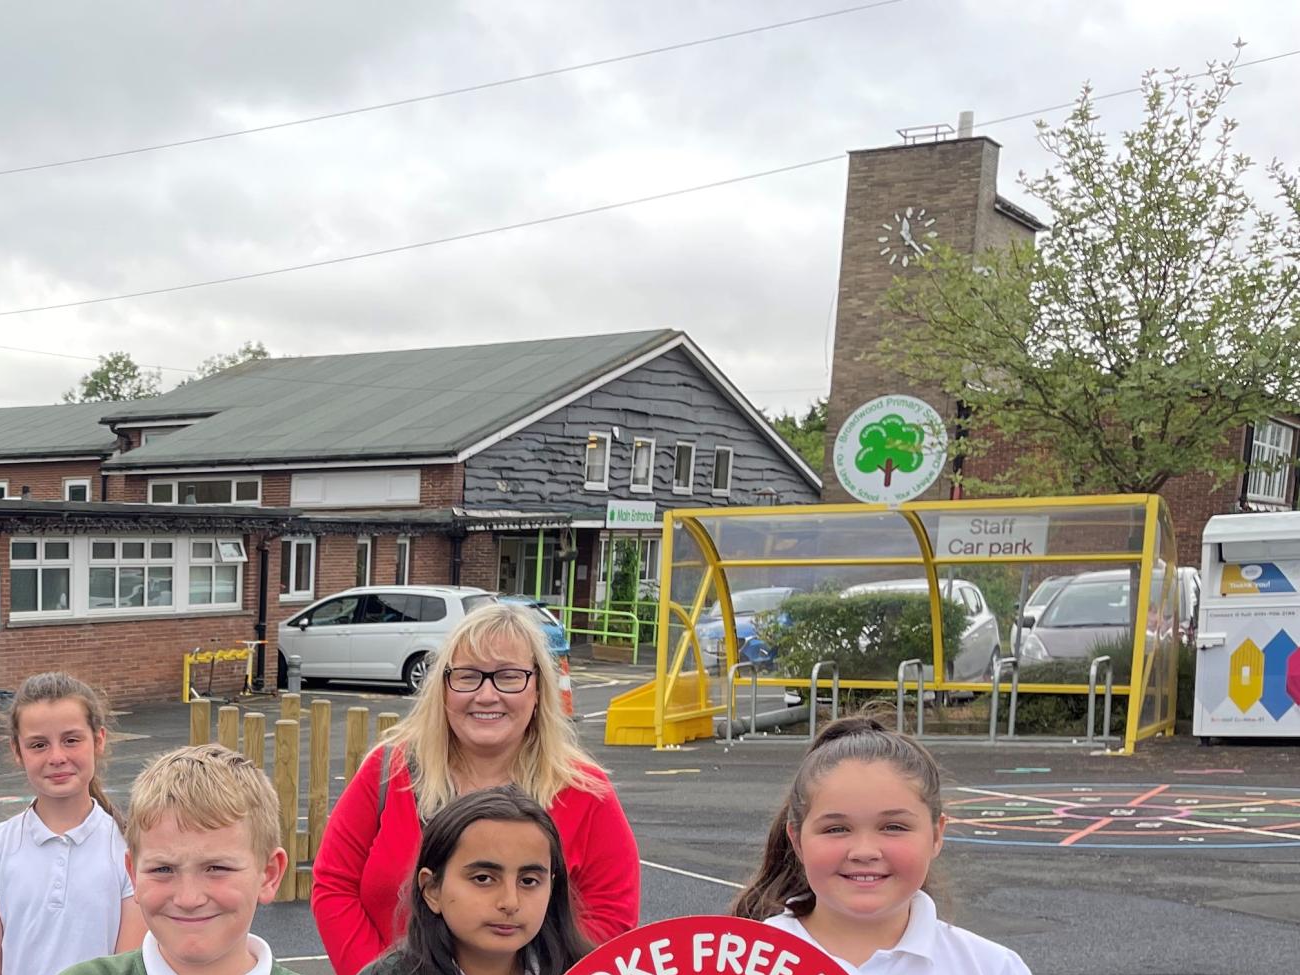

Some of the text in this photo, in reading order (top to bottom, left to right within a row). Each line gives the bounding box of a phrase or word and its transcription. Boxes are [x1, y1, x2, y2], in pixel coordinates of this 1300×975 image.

[886, 397, 924, 414] Primary
[617, 508, 653, 521] Main Entrance
[969, 518, 1016, 535] Staff
[948, 538, 1033, 557] Car park
